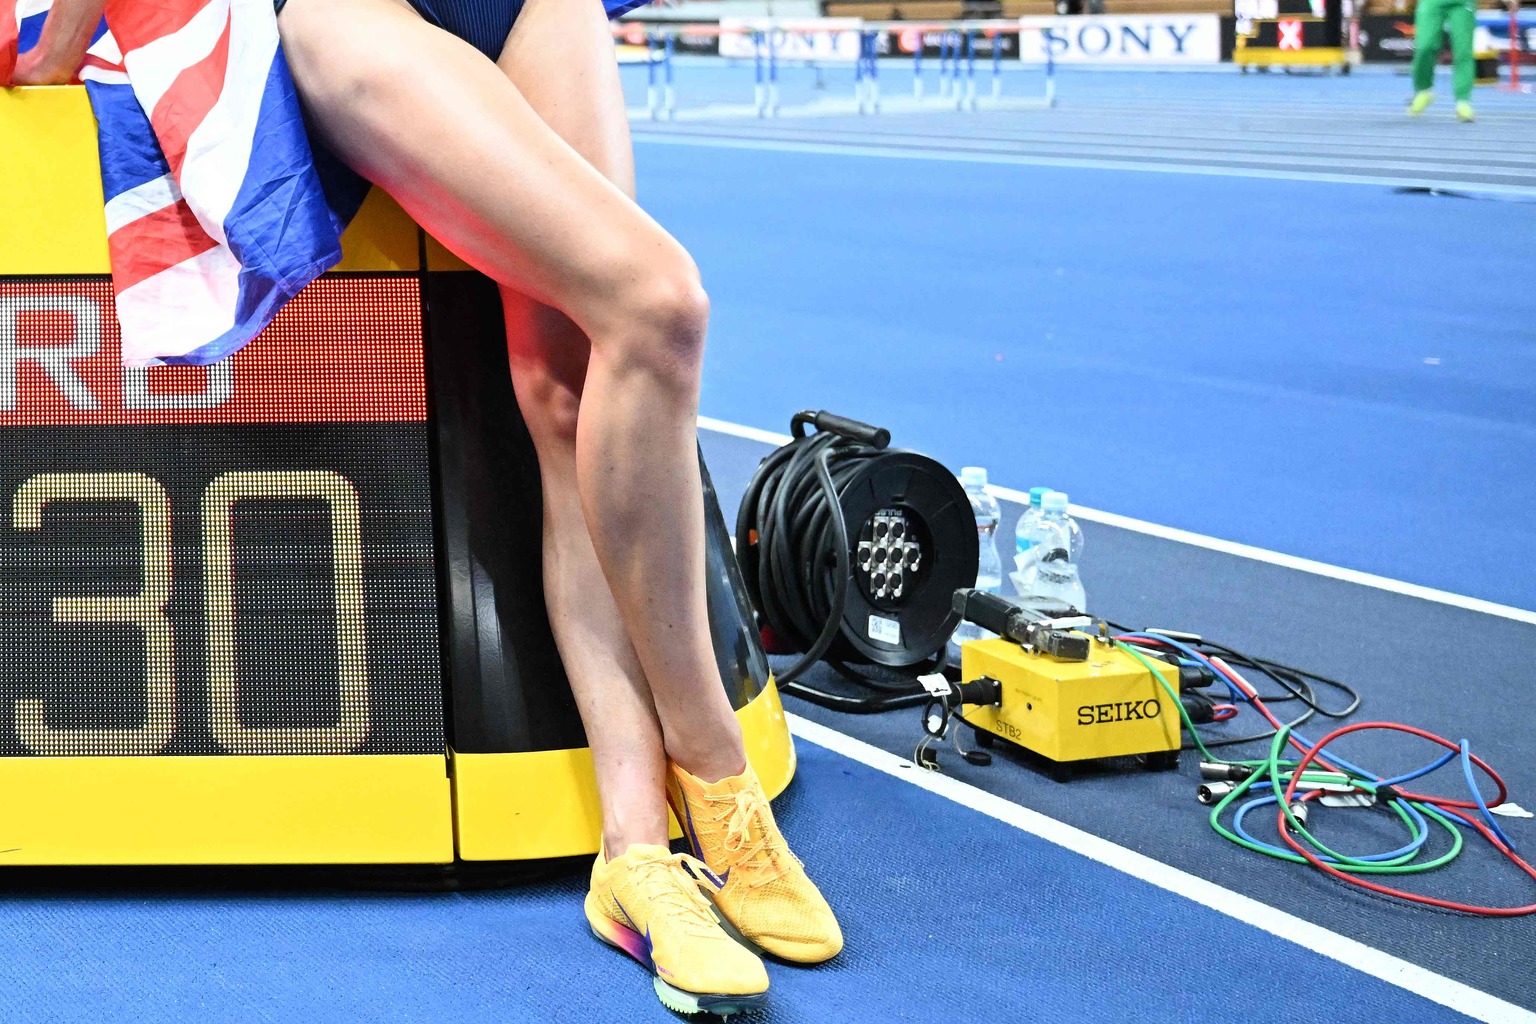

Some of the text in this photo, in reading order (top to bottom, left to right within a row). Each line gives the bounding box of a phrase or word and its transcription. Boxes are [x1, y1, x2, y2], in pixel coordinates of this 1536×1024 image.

[733, 25, 843, 54] SONY
[1042, 23, 1198, 57] SONY
[1077, 699, 1161, 726] SEIKO
[996, 719, 1022, 741] STB2
